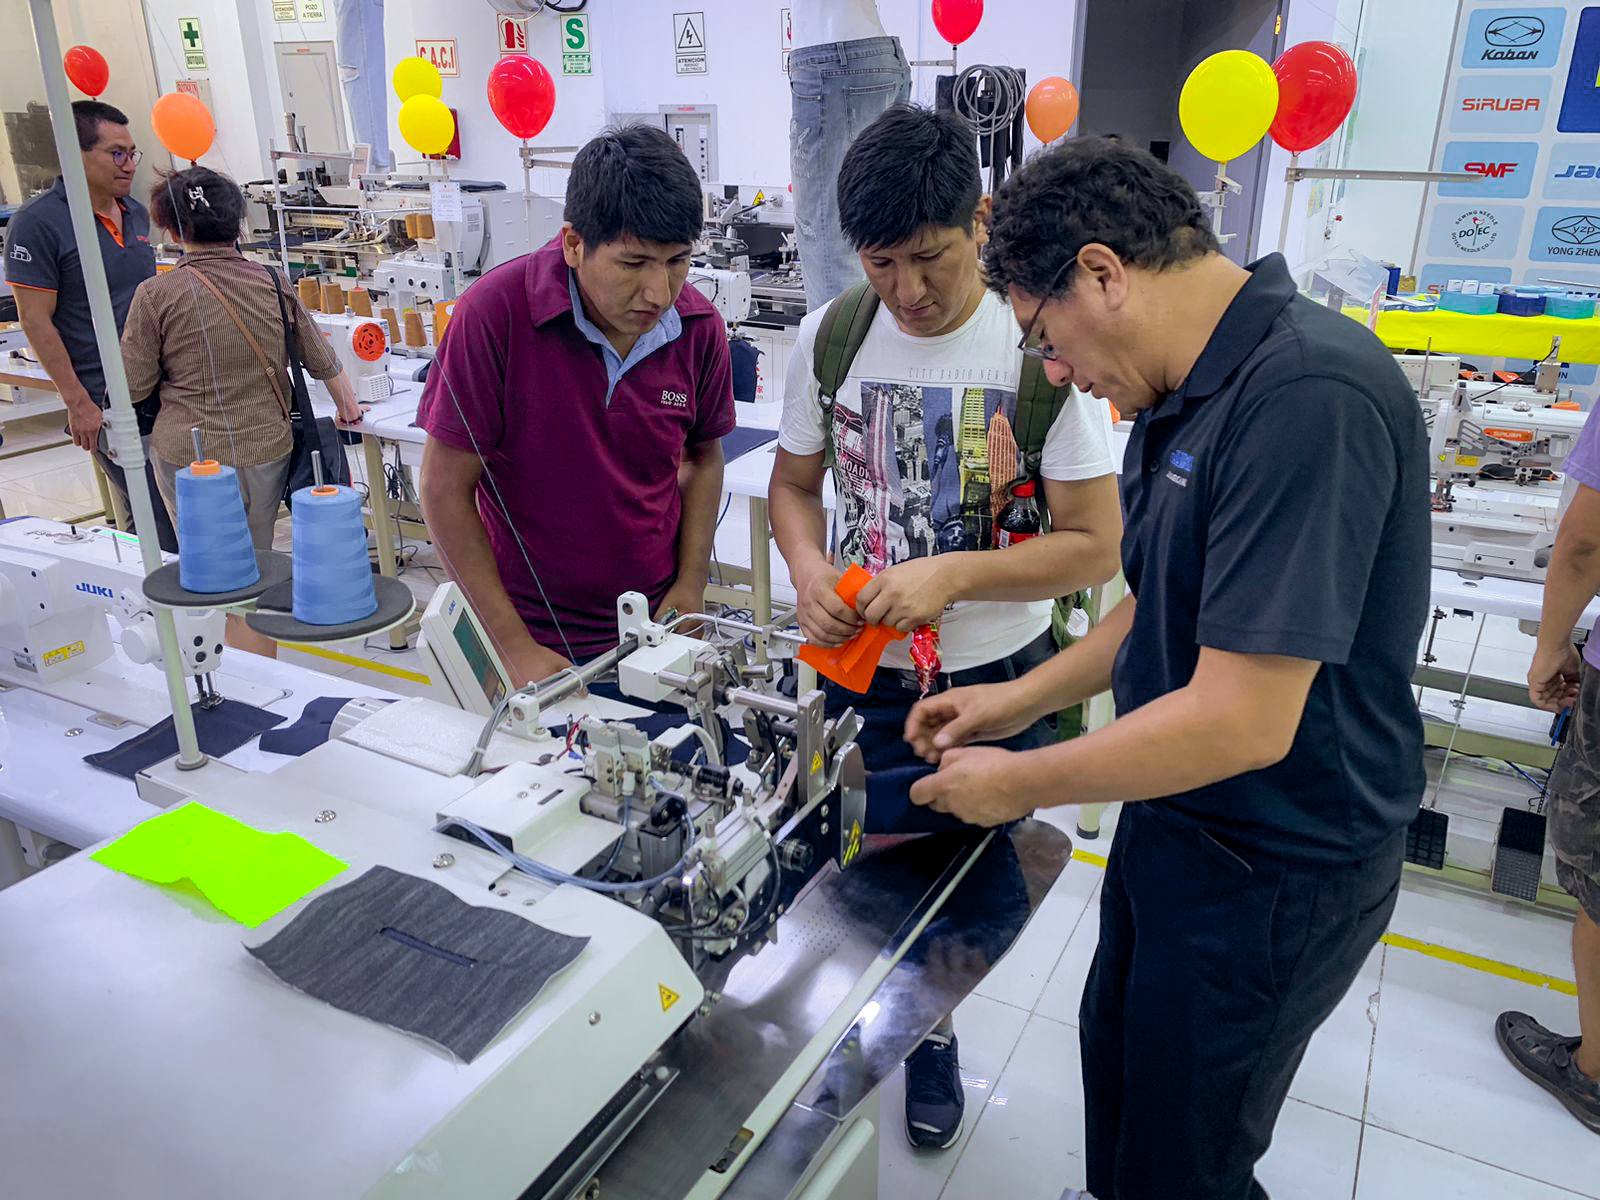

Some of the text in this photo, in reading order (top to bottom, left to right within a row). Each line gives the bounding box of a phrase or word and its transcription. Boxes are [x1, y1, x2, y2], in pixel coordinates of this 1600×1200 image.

[566, 17, 585, 50] S
[1547, 246, 1574, 256] YONG
[661, 390, 687, 403] BOSS
[76, 582, 114, 598] JUKI
